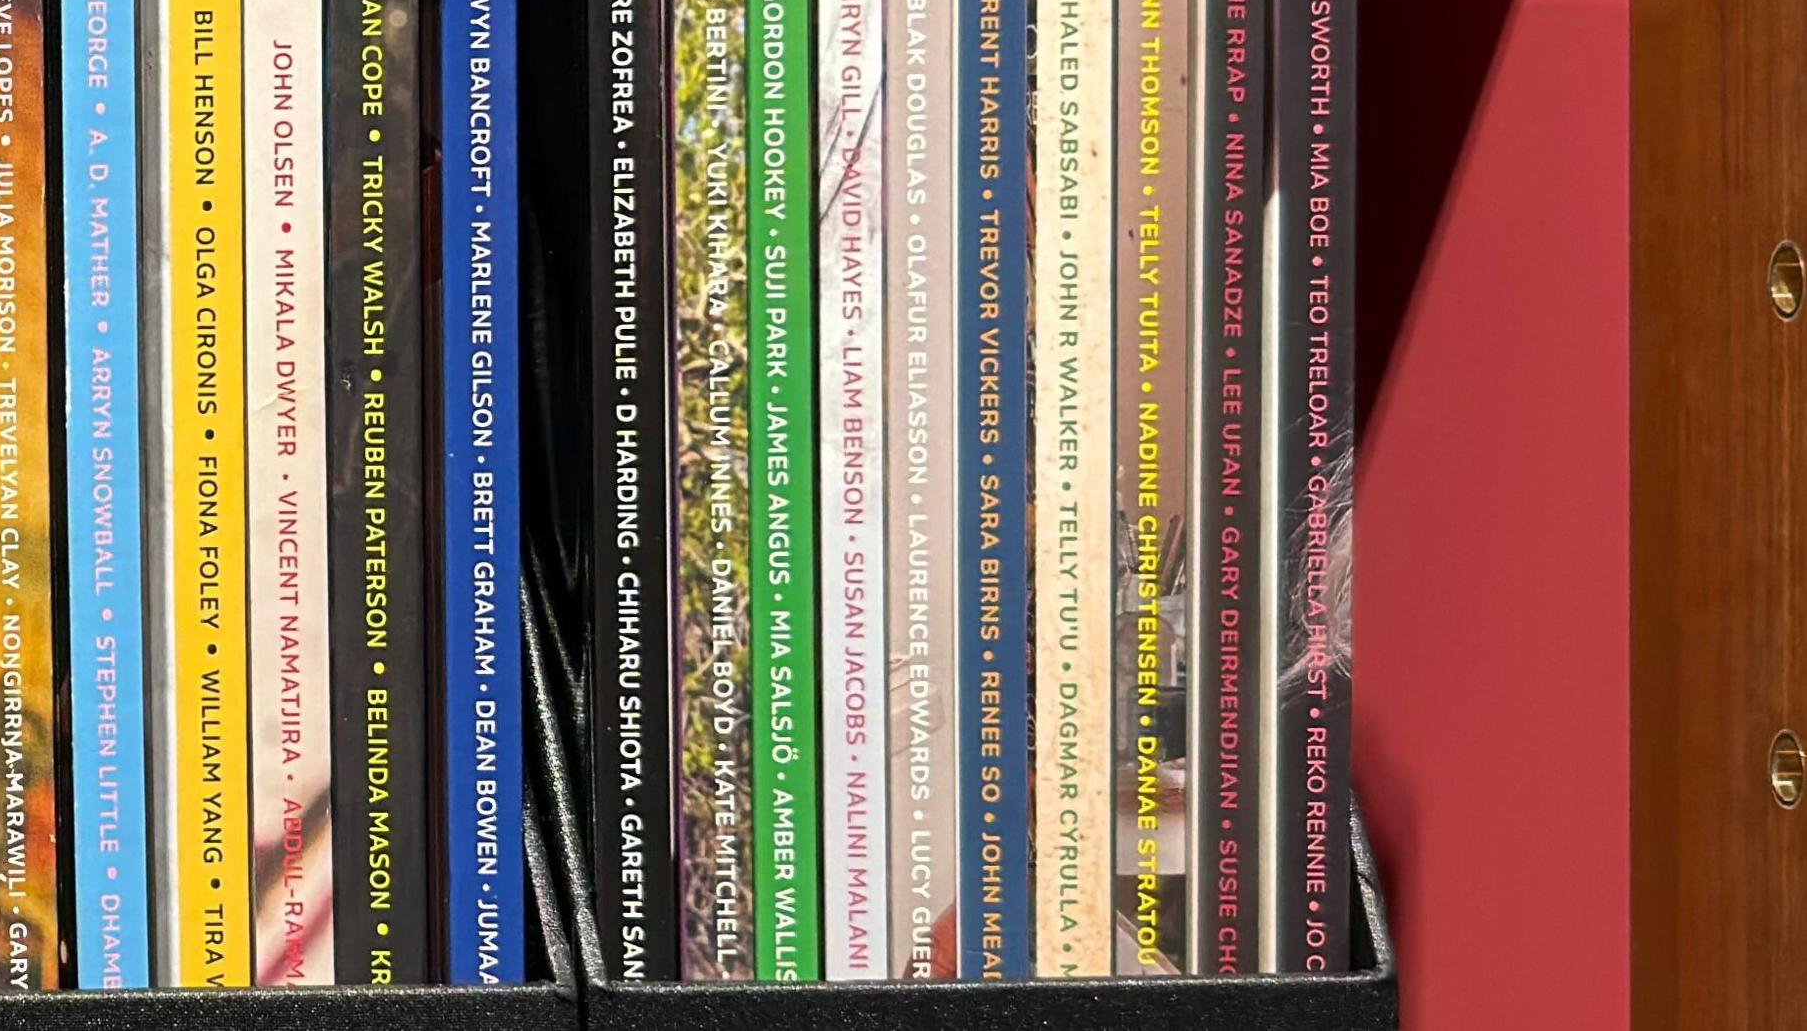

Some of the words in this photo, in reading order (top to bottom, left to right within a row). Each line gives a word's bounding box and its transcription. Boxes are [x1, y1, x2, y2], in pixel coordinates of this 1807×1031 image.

[194, 11, 214, 66] BILL
[363, 45, 382, 116] COPE
[612, 31, 634, 134] ZOFREA
[194, 74, 214, 186] HENSON
[842, 66, 862, 121] GILL
[980, 77, 999, 179] HARRIS
[1141, 38, 1161, 174] THOMSON
[96, 636, 117, 756] STEPHEN
[98, 766, 119, 853] LITTLE
